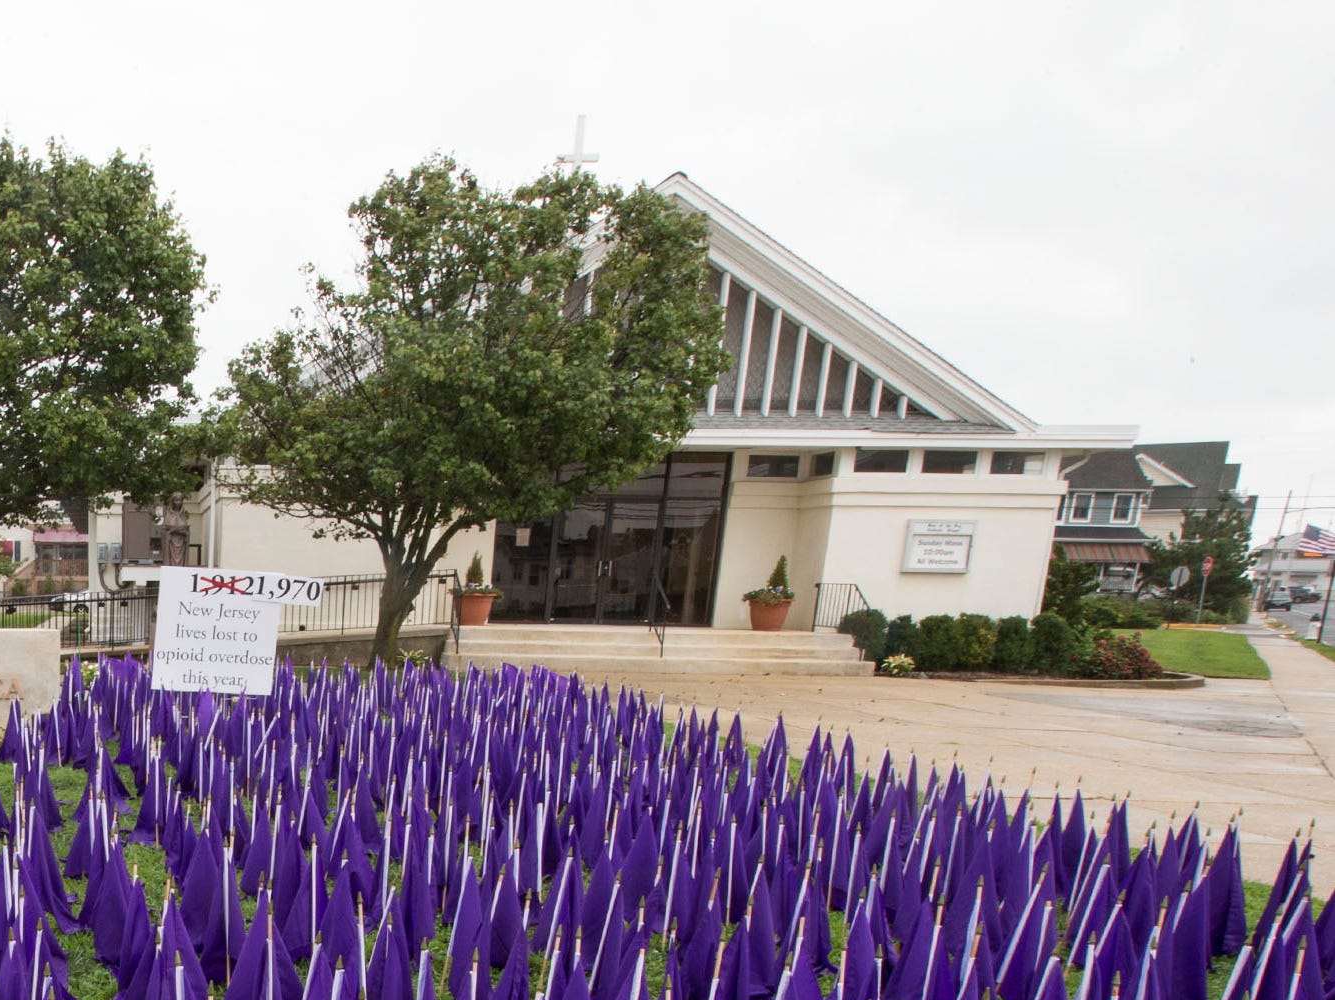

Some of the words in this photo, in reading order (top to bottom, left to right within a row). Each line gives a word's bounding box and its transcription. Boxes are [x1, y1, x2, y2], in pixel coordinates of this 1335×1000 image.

[178, 601, 214, 617] New
[215, 603, 262, 624] Jersey
[175, 623, 207, 640] lives
[212, 625, 240, 641] lost
[243, 631, 258, 643] to
[156, 647, 204, 665] opioid
[208, 649, 273, 666] overdose
[182, 669, 209, 685] this
